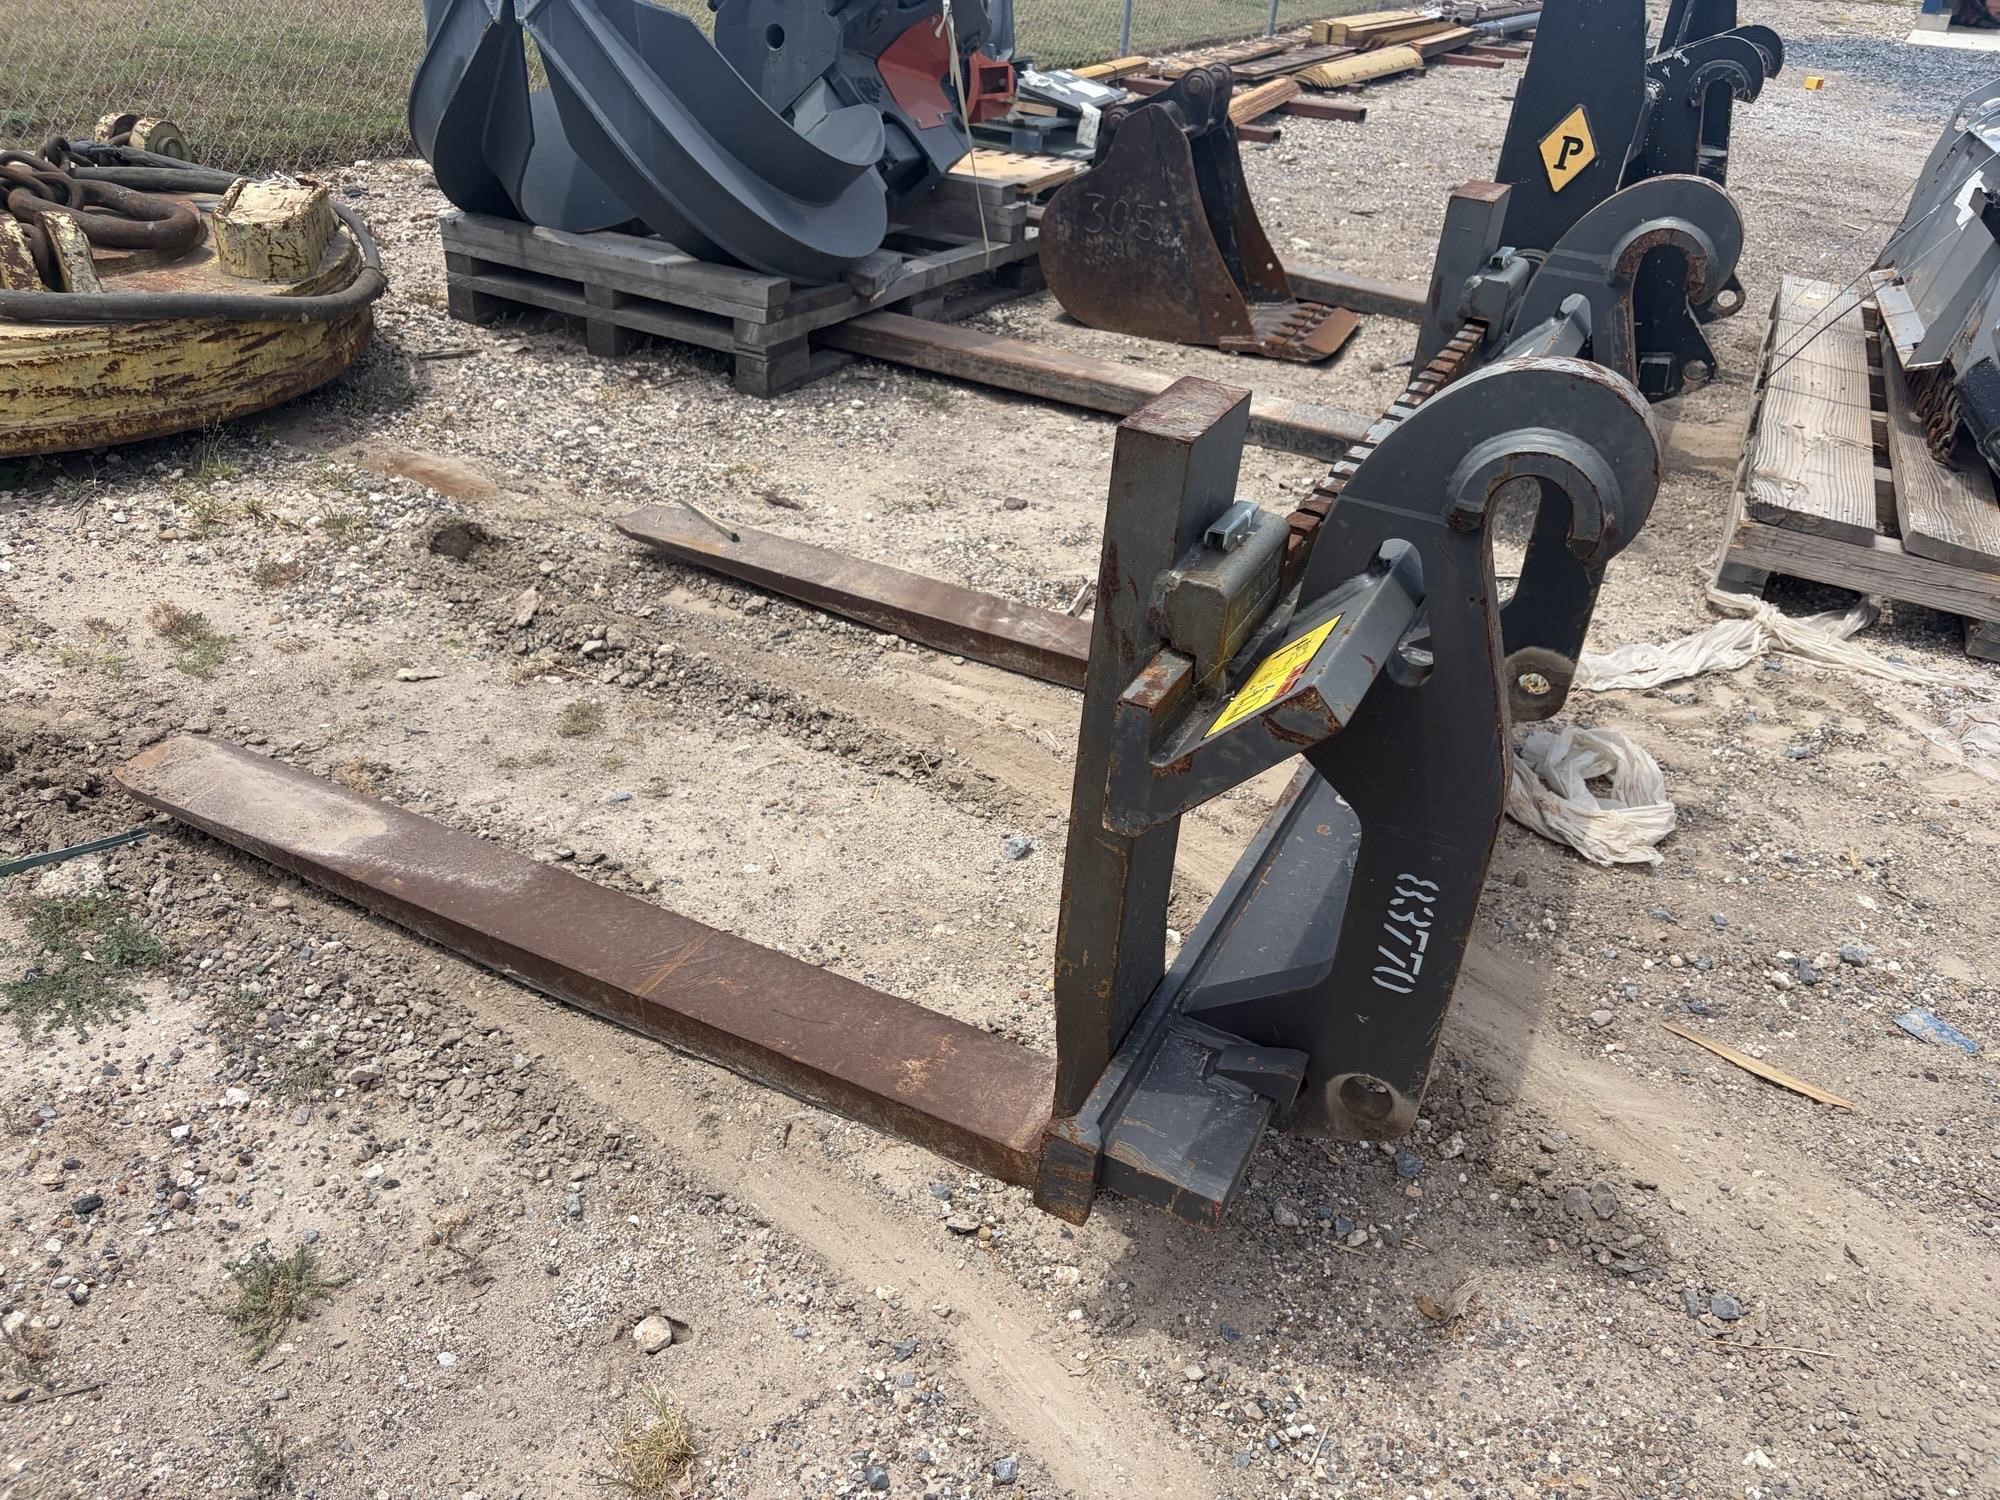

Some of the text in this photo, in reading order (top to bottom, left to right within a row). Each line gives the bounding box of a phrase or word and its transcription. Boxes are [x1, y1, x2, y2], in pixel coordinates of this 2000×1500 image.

[1553, 135, 1584, 170] P
[1084, 193, 1155, 242] 305
[1371, 873, 1440, 994] 83770
